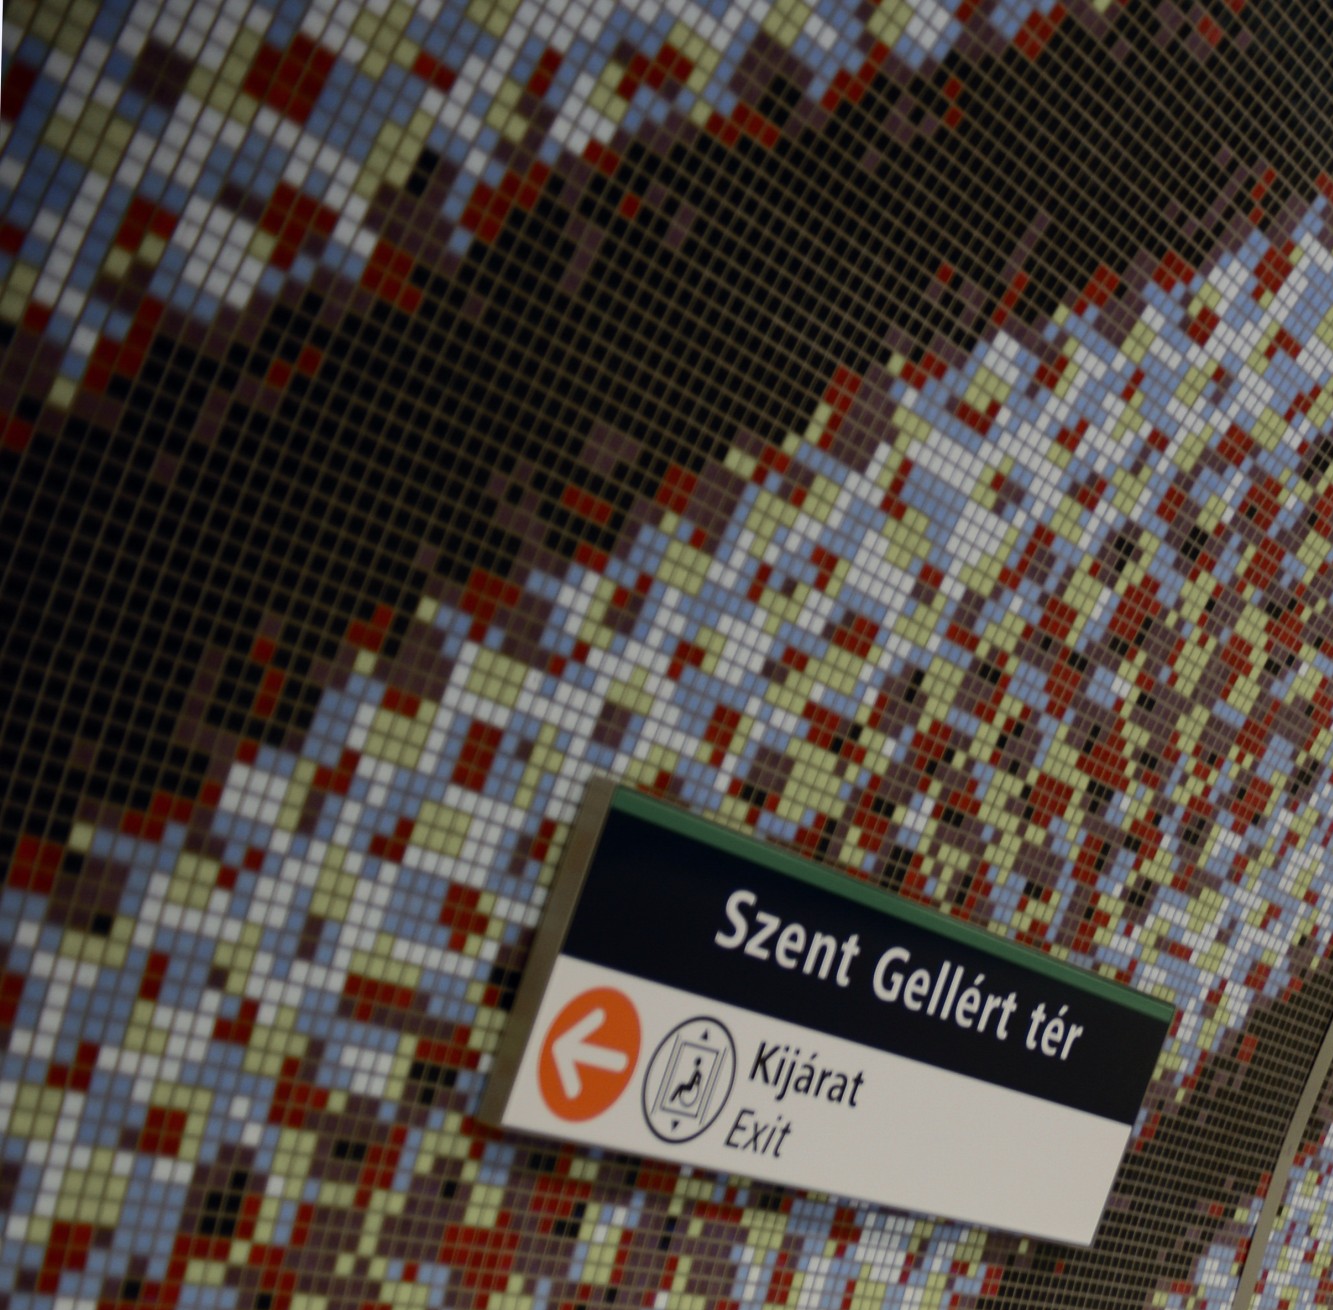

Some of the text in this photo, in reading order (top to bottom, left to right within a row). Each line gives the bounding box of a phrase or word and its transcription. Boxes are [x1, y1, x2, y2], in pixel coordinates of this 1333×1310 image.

[714, 888, 1085, 1061] Szent Gellért tér
[748, 1040, 866, 1109] Kijárat
[724, 1107, 794, 1160] Exit
